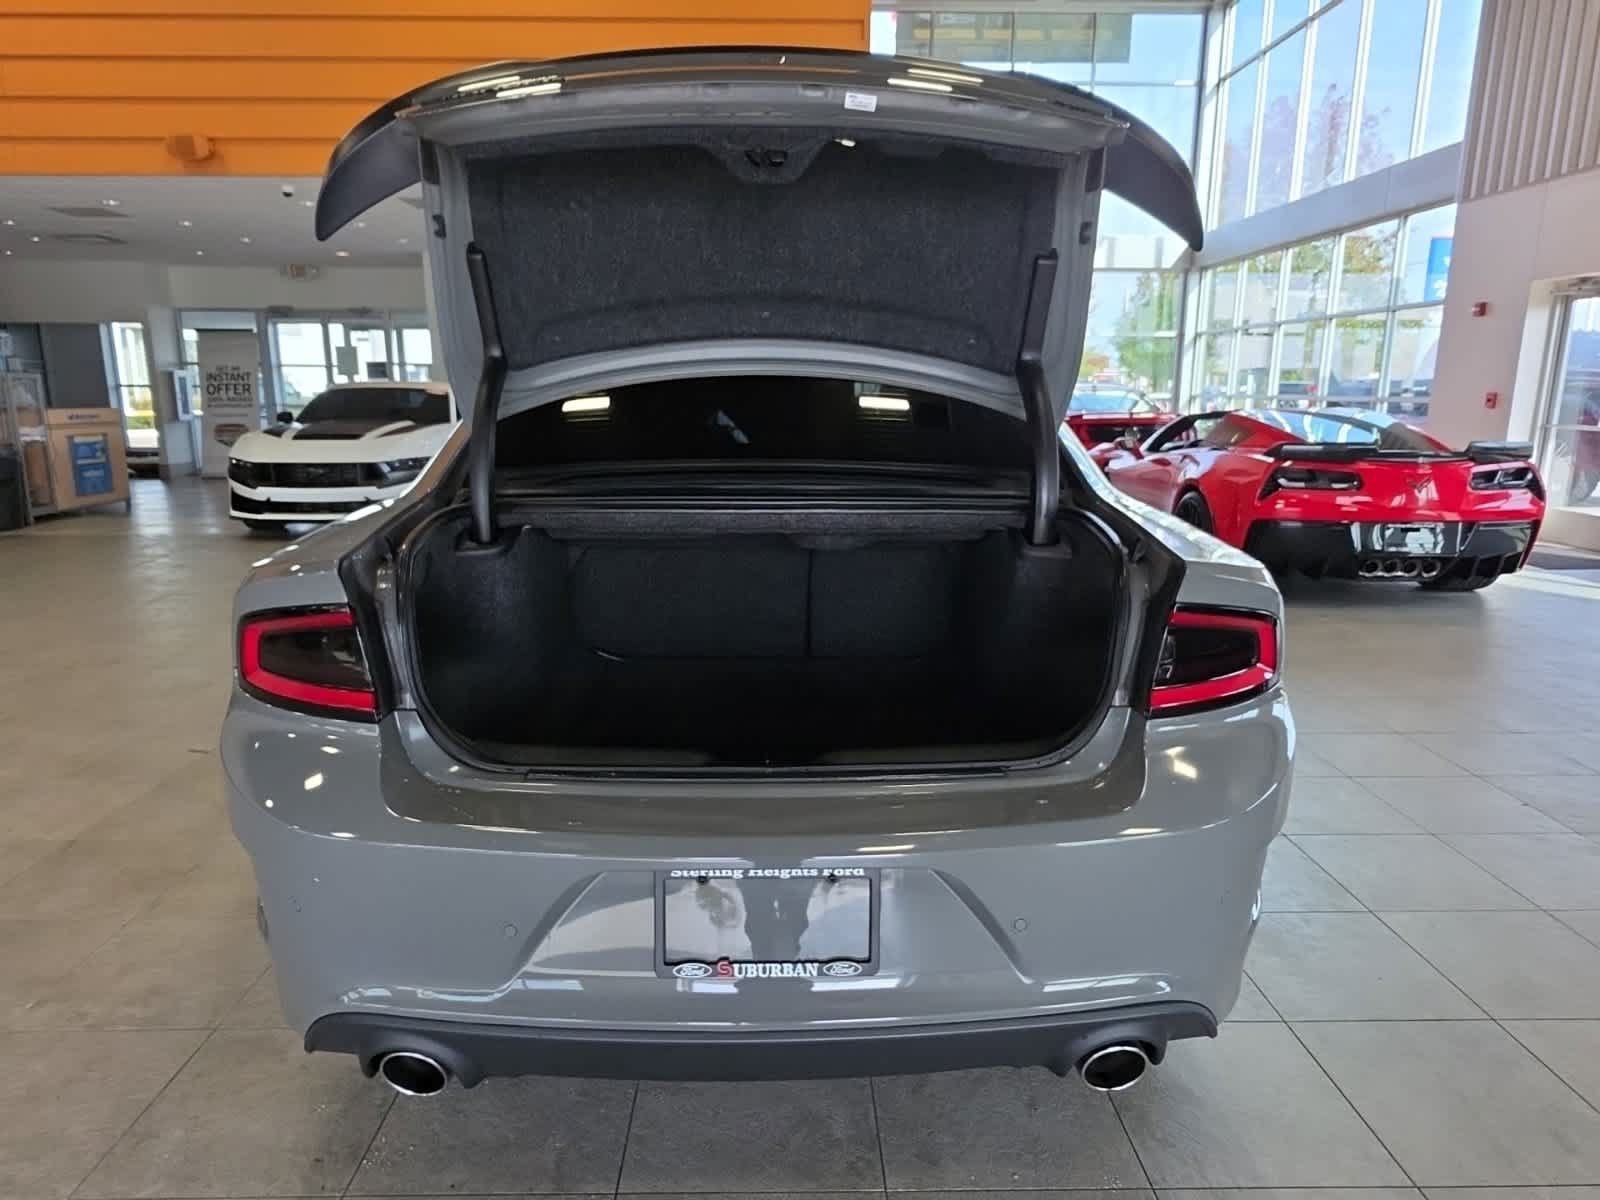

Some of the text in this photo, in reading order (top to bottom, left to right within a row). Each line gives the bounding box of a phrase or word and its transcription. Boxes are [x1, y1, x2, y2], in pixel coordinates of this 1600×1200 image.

[206, 371, 252, 382] INSTANT
[206, 383, 252, 396] OFFER
[716, 961, 819, 978] SUBURBAN
